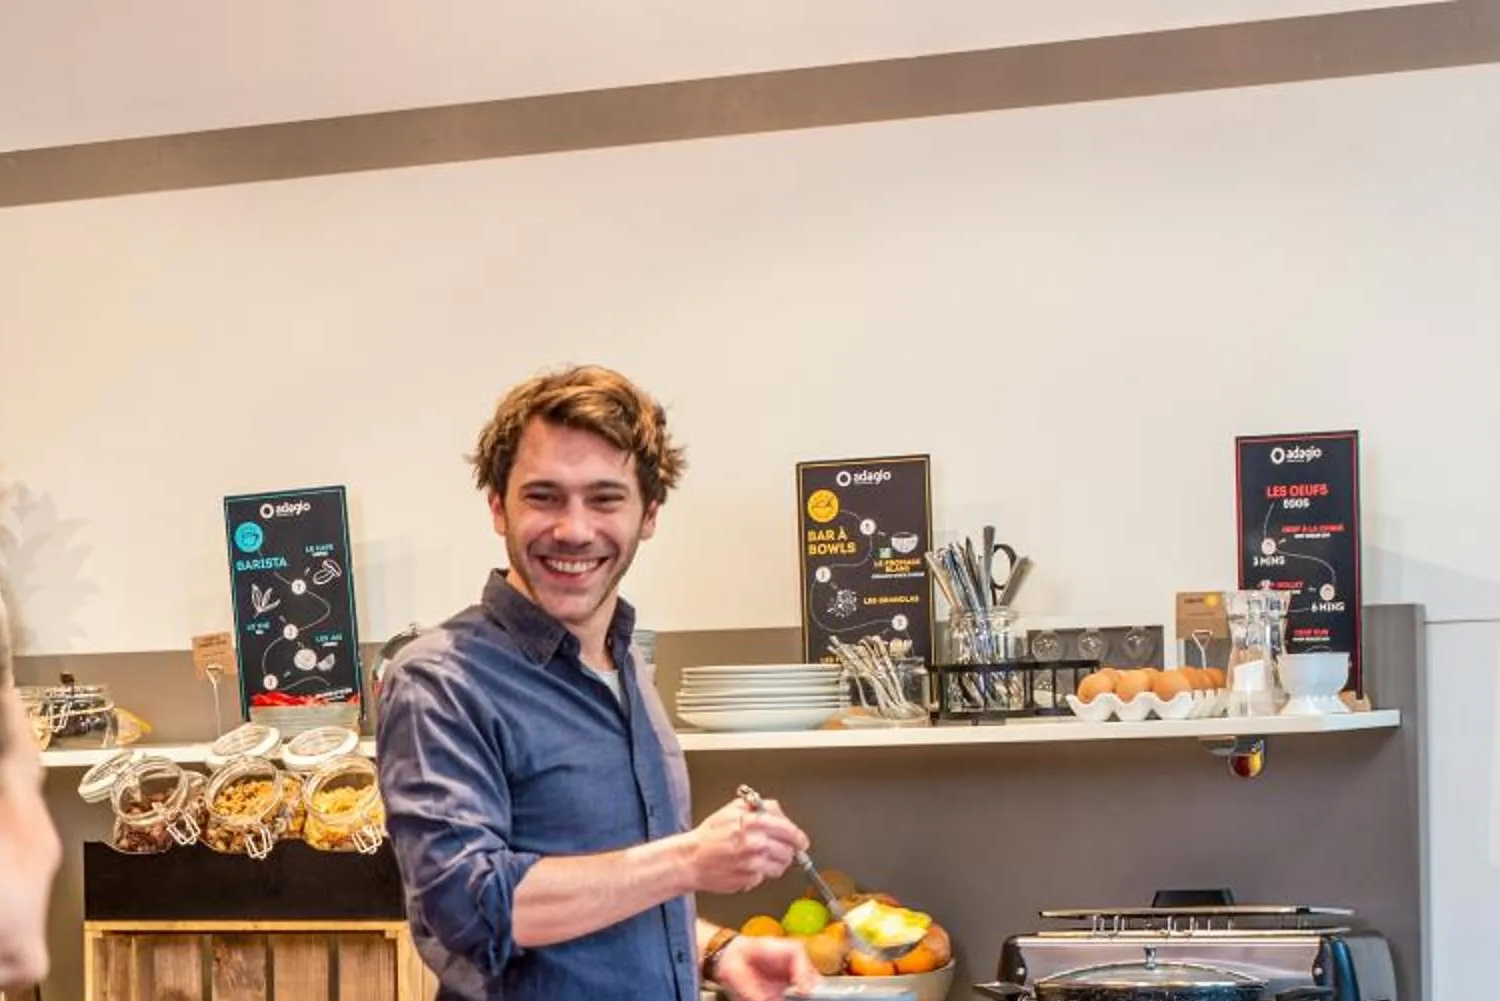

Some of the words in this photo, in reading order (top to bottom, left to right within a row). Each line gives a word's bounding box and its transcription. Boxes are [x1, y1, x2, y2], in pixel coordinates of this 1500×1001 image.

[1286, 445, 1322, 462] adagio
[854, 470, 891, 485] adagio
[1267, 485, 1287, 497] LES
[1290, 483, 1329, 497] OEUFS
[276, 500, 311, 515] adagio
[808, 529, 835, 541] BAR
[808, 542, 856, 555] BOWLS
[236, 556, 287, 571] BARISTA
